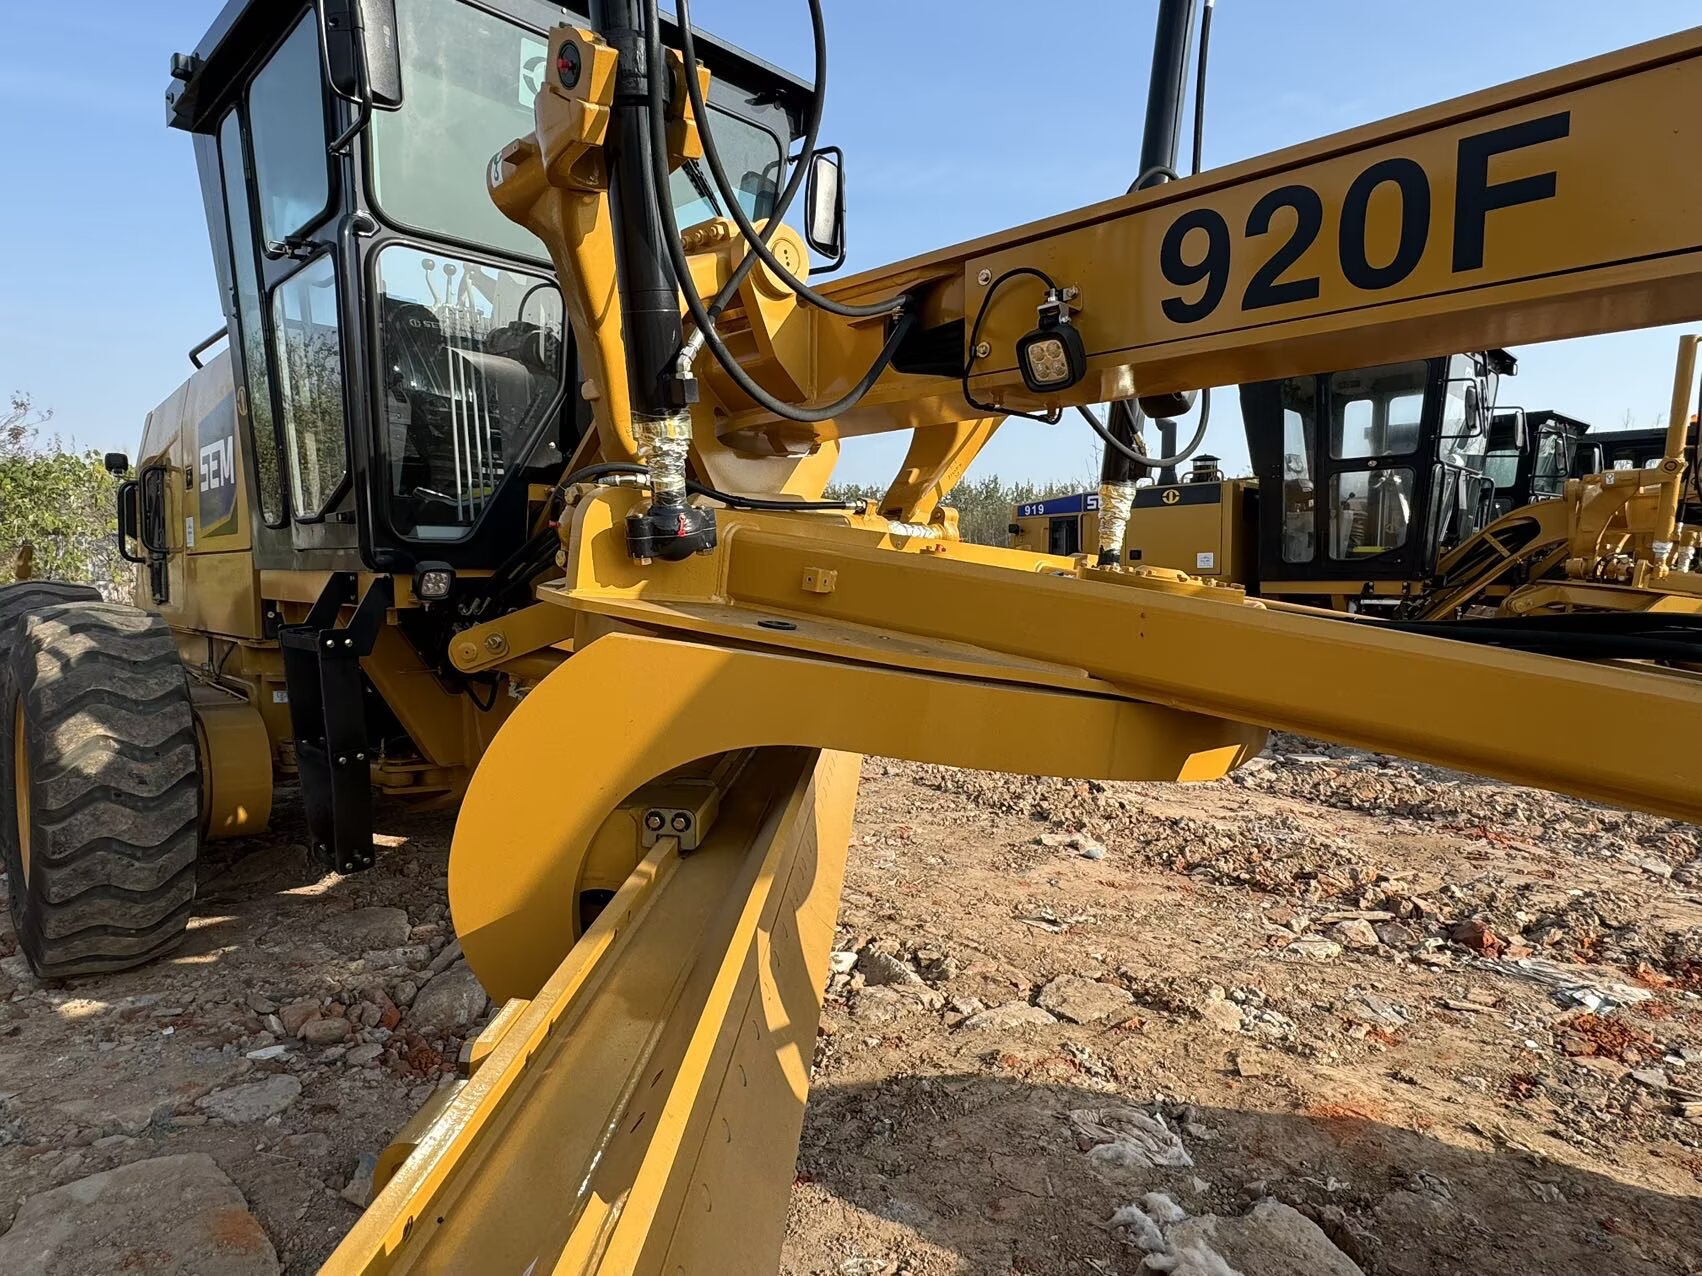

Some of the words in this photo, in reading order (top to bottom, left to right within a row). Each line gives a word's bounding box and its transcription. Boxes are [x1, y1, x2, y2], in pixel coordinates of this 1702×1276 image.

[1160, 111, 1570, 323] 920F
[200, 435, 234, 492] SEM
[1024, 504, 1044, 516] 919
[1086, 495, 1100, 510] S
